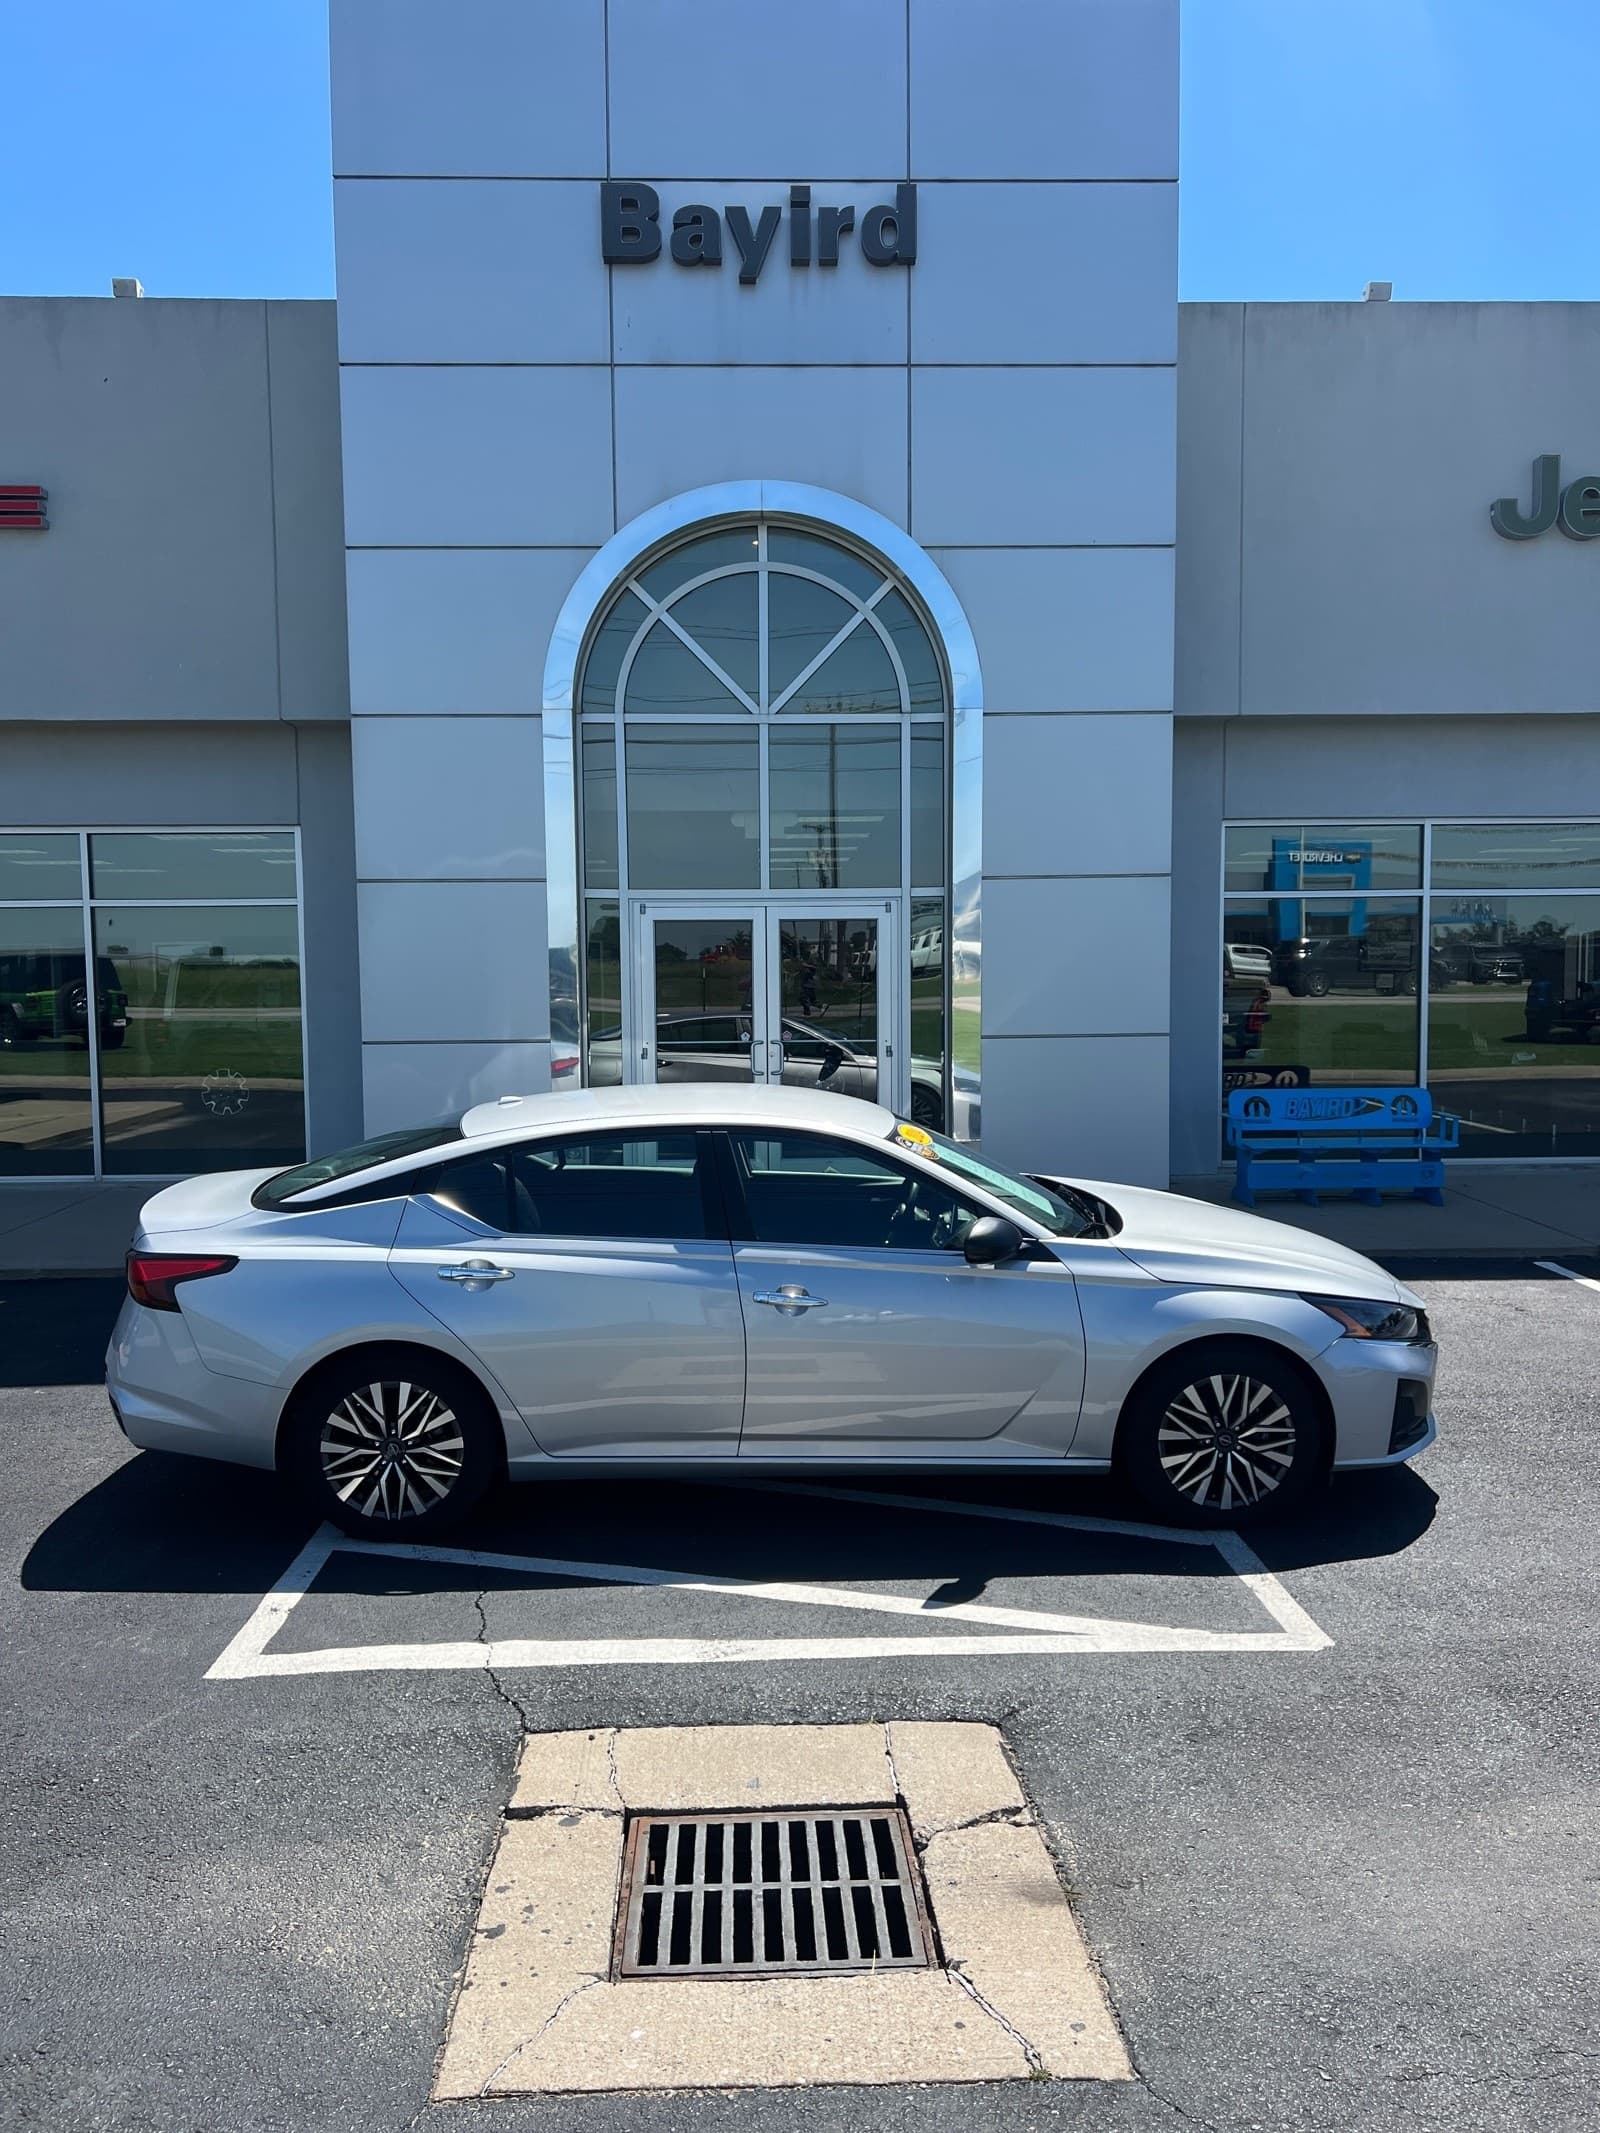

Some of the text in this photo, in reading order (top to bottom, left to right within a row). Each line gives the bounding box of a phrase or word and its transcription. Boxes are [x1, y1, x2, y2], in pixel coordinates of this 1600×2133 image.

[600, 182, 917, 285] Bayird
[1490, 454, 1600, 541] Je
[1287, 1097, 1355, 1119] BAYIRD
